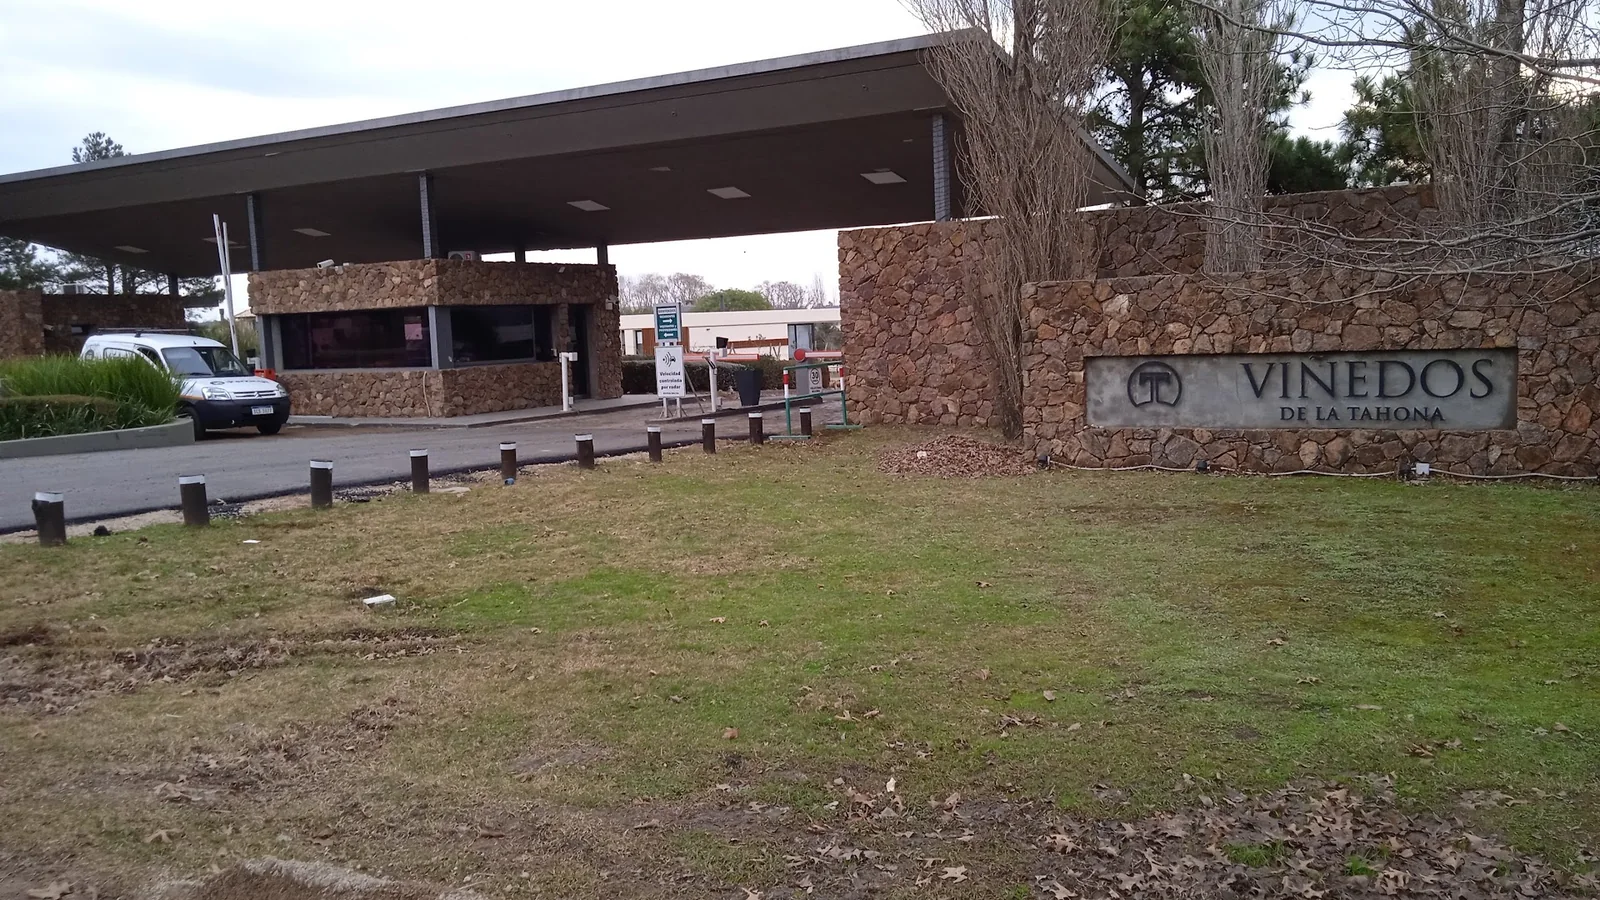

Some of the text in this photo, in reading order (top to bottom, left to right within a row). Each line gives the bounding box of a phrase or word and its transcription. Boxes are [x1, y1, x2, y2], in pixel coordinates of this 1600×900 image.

[1280, 406, 1445, 422] DE LA TAHONA
